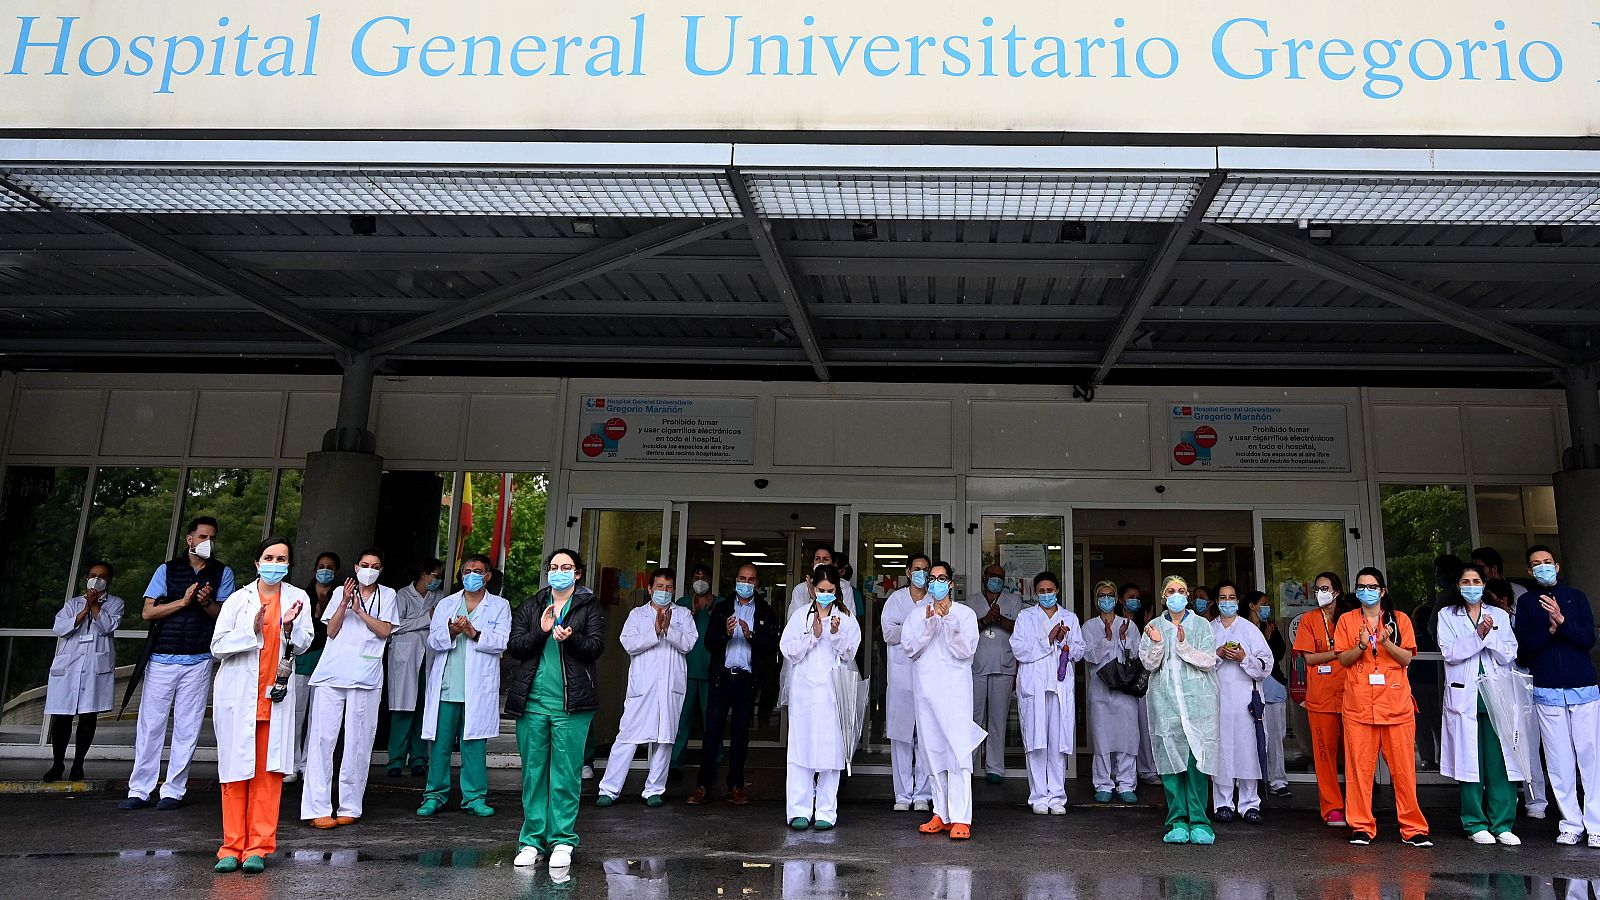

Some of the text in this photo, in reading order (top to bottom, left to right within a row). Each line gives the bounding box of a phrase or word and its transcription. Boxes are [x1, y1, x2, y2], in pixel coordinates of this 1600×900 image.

[6, 14, 320, 93] Hospital
[352, 13, 644, 77] General
[683, 16, 1179, 78] Universitario
[1212, 18, 1563, 99] Gregorio
[606, 405, 643, 414] Gregorio
[646, 405, 683, 413] Marañón
[1194, 413, 1231, 422] Gregorio
